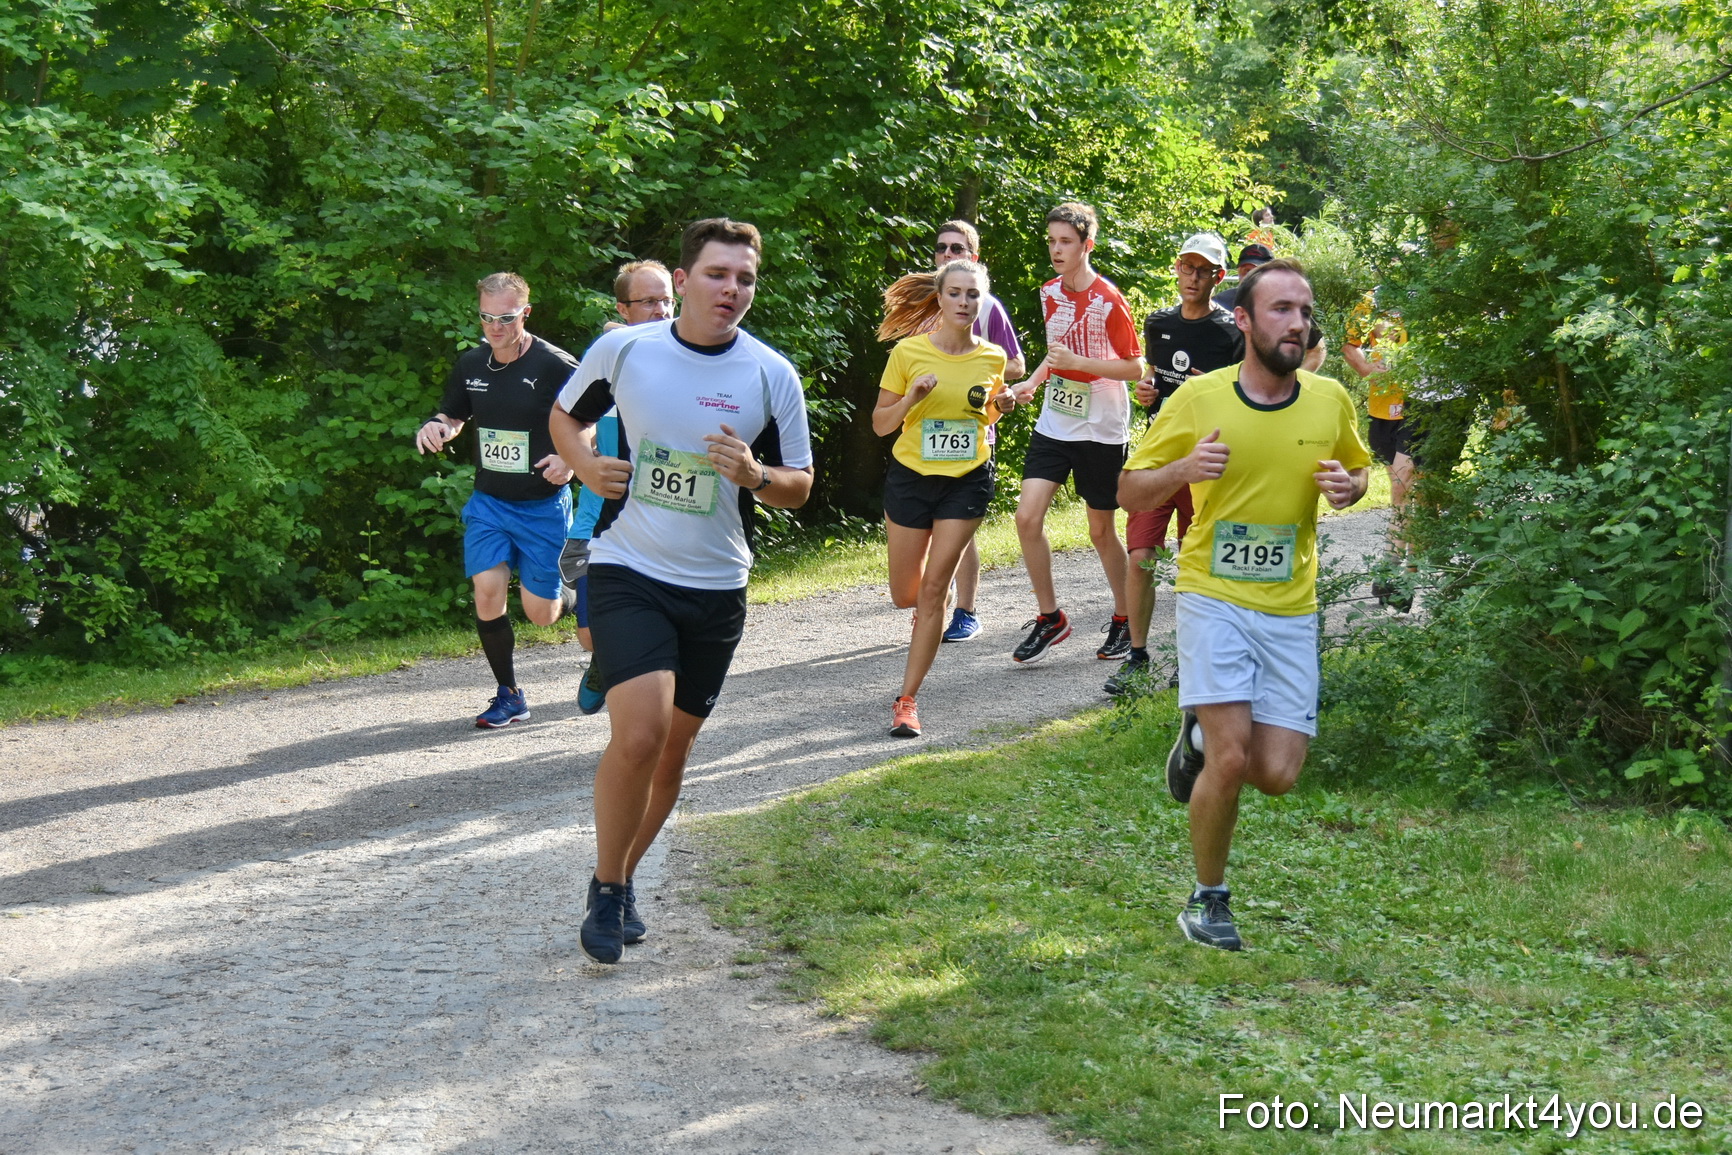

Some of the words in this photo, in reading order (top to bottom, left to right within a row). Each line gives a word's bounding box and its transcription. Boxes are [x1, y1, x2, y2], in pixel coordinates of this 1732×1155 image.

[705, 401, 741, 410] partner
[1052, 388, 1083, 408] 2212
[929, 434, 970, 449] 1763
[484, 443, 521, 461] 2403
[650, 467, 697, 497] 961
[650, 488, 673, 500] Mandel
[673, 495, 697, 504] Marius
[1221, 542, 1284, 566] 2195
